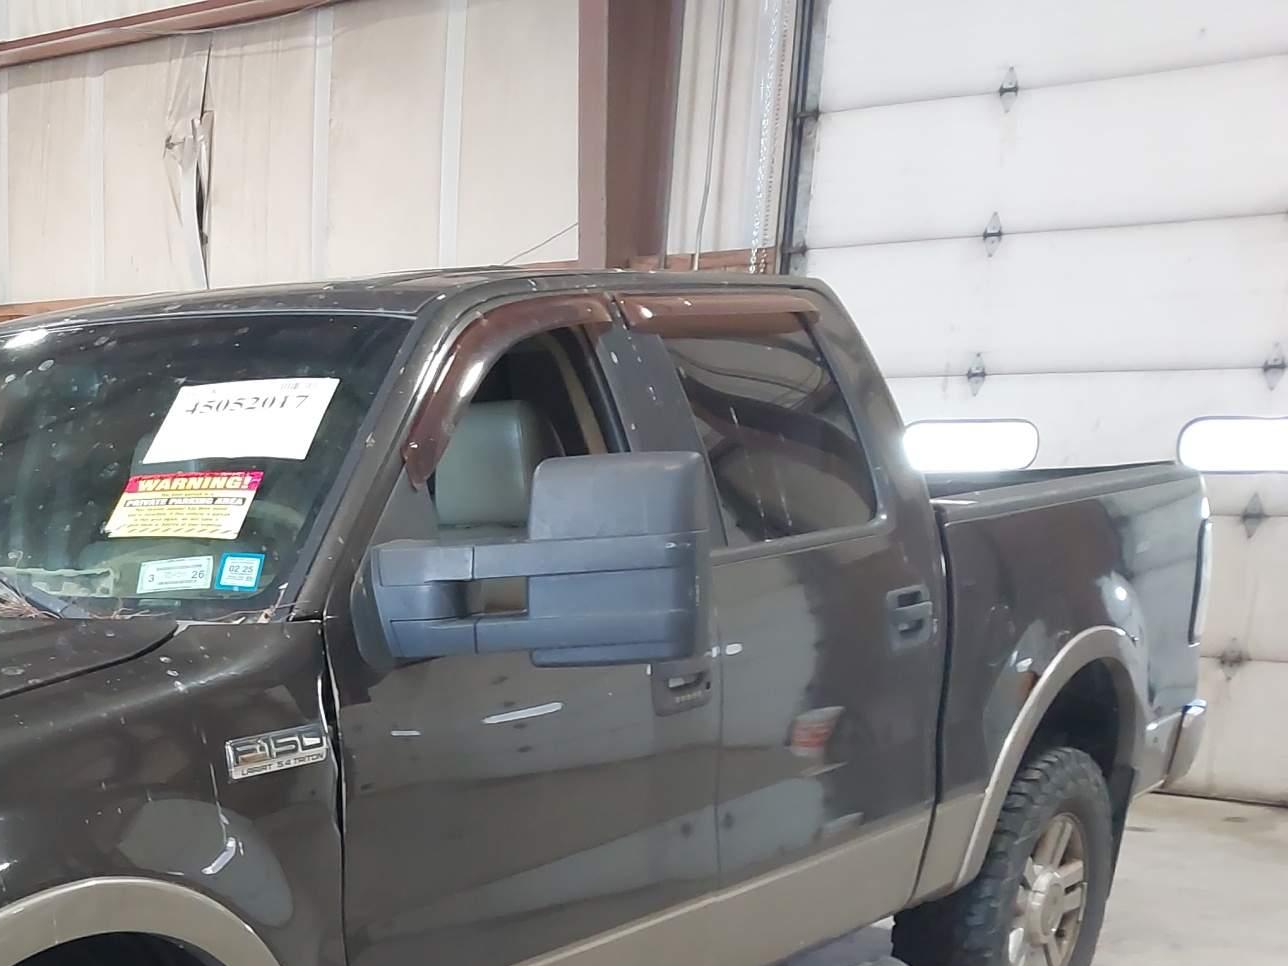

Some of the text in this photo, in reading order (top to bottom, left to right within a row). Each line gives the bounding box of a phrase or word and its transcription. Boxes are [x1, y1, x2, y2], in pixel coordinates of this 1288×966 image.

[185, 395, 310, 415] 45052017
[138, 473, 252, 492] WARNING!
[148, 574, 155, 583] 3
[191, 570, 205, 579] 26
[228, 565, 254, 573] 02 25
